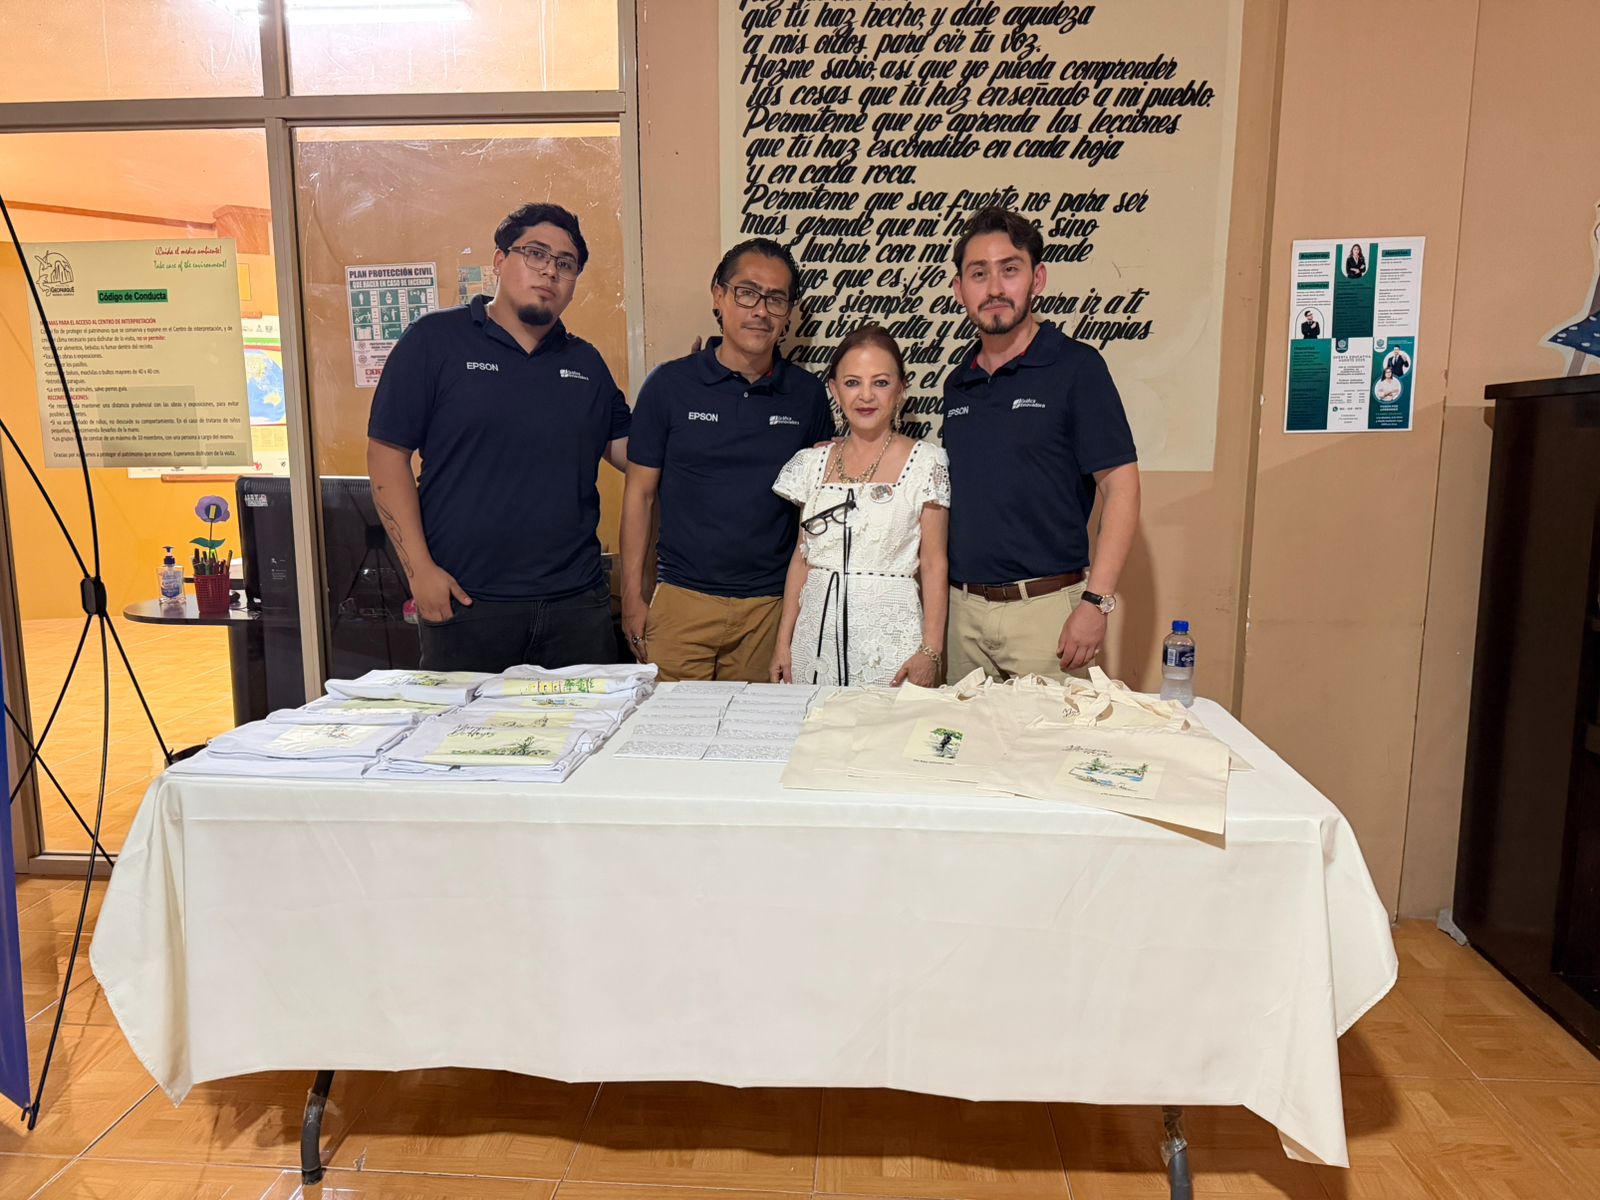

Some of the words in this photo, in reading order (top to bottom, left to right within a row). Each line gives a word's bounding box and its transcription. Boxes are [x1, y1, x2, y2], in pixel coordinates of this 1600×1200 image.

[741, 7, 782, 38] que
[784, 2, 810, 28] tú
[814, 2, 858, 38] haz
[860, 2, 926, 30] hecho,
[930, 7, 948, 36] y
[950, 0, 1000, 27] dale
[1002, 0, 1096, 35] agudeza
[742, 34, 764, 54] a
[768, 29, 809, 54] mis
[874, 31, 929, 61] para
[970, 27, 996, 53] tu
[1000, 31, 1042, 60] voz.
[740, 54, 815, 86] Hazme
[821, 55, 878, 81] sabio,
[880, 54, 920, 80] así
[918, 59, 957, 86] que
[958, 60, 989, 88] yo
[988, 54, 1056, 86] pueda
[1060, 54, 1178, 88] comprender
[746, 78, 783, 108] las
[790, 86, 853, 106] cosas
[859, 86, 898, 114] que
[900, 81, 928, 106] tú
[926, 81, 973, 114] haz
[977, 81, 1090, 106] enseñado
[1093, 87, 1113, 106] a
[1113, 81, 1148, 107] mi
[1138, 80, 1216, 116] pueblo.
[742, 103, 868, 138] Permíteme
[872, 112, 913, 141] que
[912, 112, 944, 143] yo
[947, 108, 1040, 142] aprenda
[1046, 108, 1082, 133] las
[1088, 108, 1182, 135] lecciones
[745, 138, 785, 166] que
[786, 134, 816, 158] tú
[814, 134, 860, 168] haz
[866, 133, 981, 158] escondido
[982, 140, 1012, 158] en
[1013, 134, 1071, 158] cada
[1070, 134, 1126, 168] hoja
[743, 164, 759, 196] y
[768, 164, 798, 184] en
[799, 160, 857, 184] cada
[862, 164, 917, 185] roca.
[741, 184, 860, 214] Permíteme
[864, 192, 904, 220] que
[907, 191, 948, 211] sea
[1021, 192, 1051, 213] no
[1051, 188, 1110, 220] para
[1113, 190, 1150, 213] ser
[740, 211, 789, 236] más
[792, 212, 874, 245] grande
[876, 217, 915, 245] que
[913, 212, 942, 237] mi
[1048, 213, 1100, 238] sino
[800, 236, 871, 264] luchar
[876, 242, 916, 264] con
[918, 238, 953, 263] mi
[349, 270, 367, 278] PLAN
[368, 267, 413, 278] PROTECCIÓN
[414, 267, 433, 276] CIVIL
[832, 268, 874, 296] que
[98, 291, 123, 303] Código
[124, 292, 132, 300] de
[134, 291, 167, 300] Conducta
[798, 295, 837, 320] que
[839, 289, 924, 320] siempre
[1080, 288, 1102, 316] ir
[1104, 296, 1126, 314] a
[1122, 288, 1150, 314] ti
[795, 314, 823, 338] la
[936, 320, 955, 349] y
[1072, 314, 1154, 350] limpias
[466, 362, 499, 372] EPSON
[920, 364, 946, 389] el
[688, 412, 718, 422] EPSON
[947, 406, 969, 418] EPSON
